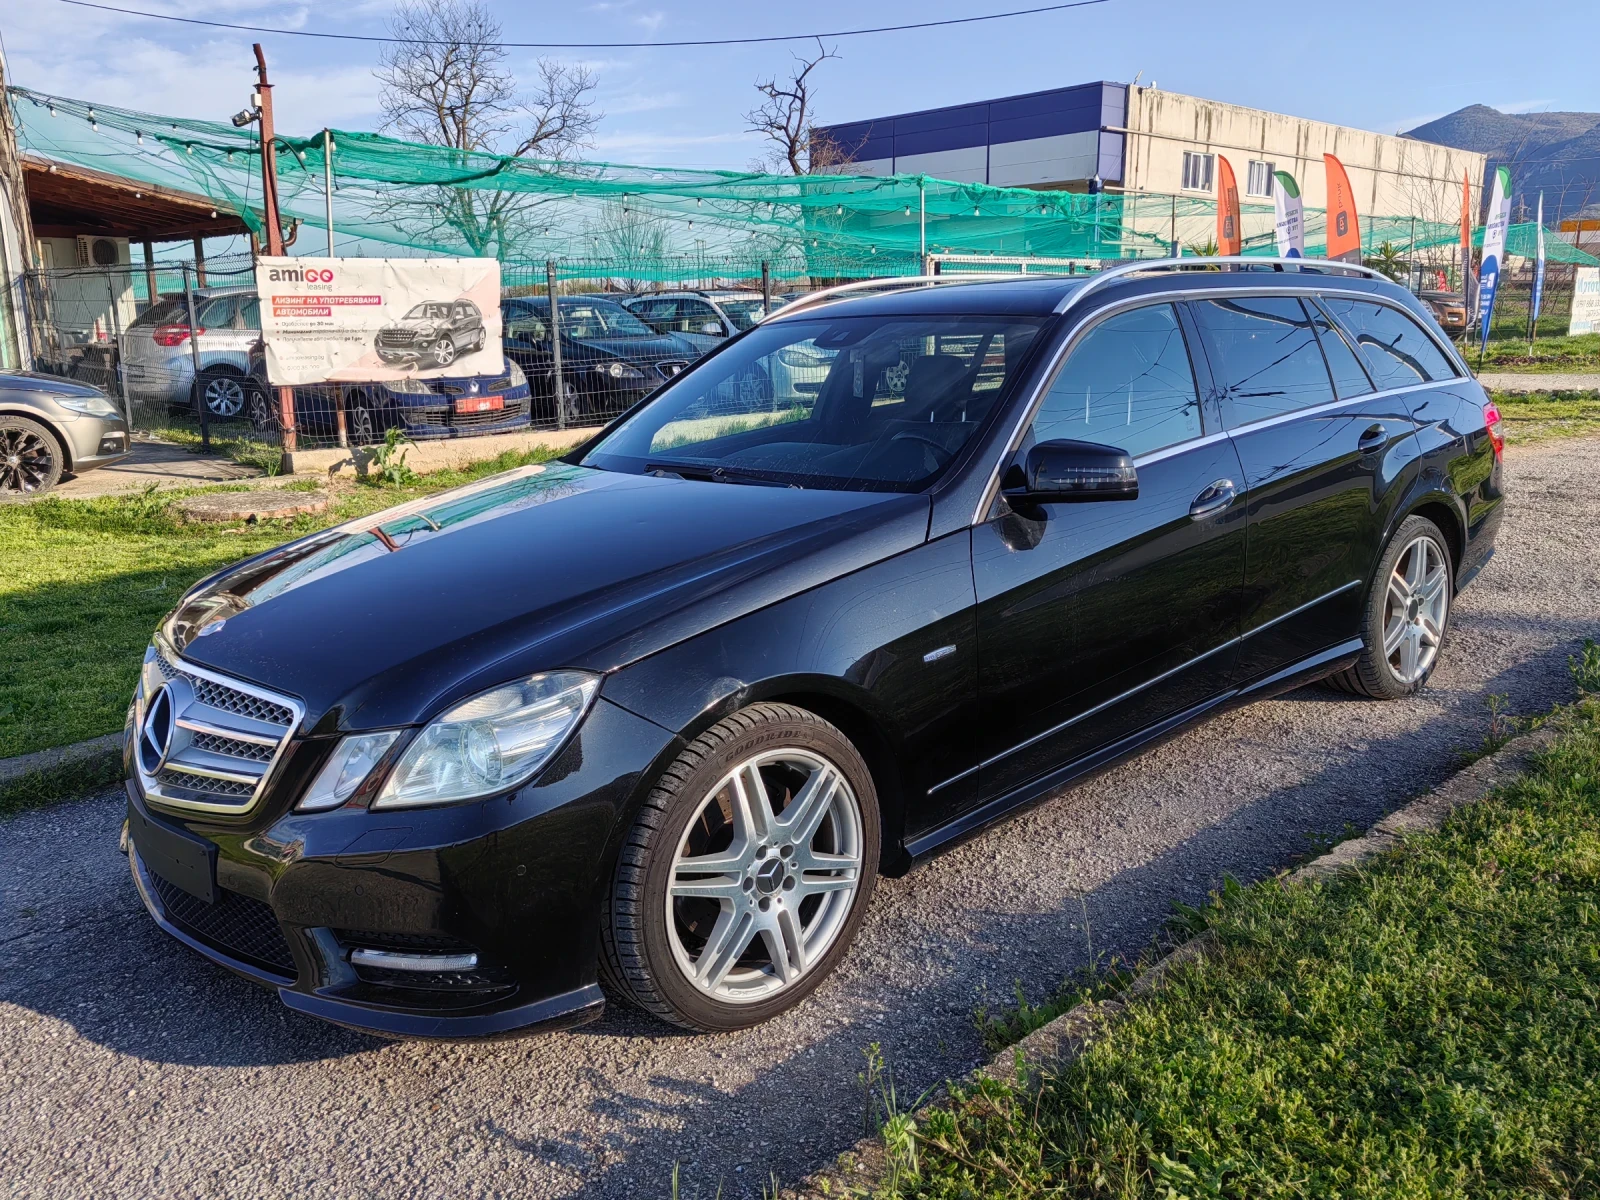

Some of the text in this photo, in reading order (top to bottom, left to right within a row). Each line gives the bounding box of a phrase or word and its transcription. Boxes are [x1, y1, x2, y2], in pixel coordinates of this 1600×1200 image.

[306, 283, 333, 292] leasing
[275, 308, 329, 316] АВТОМОБИЛИ
[725, 730, 802, 762] GOODRIDE
